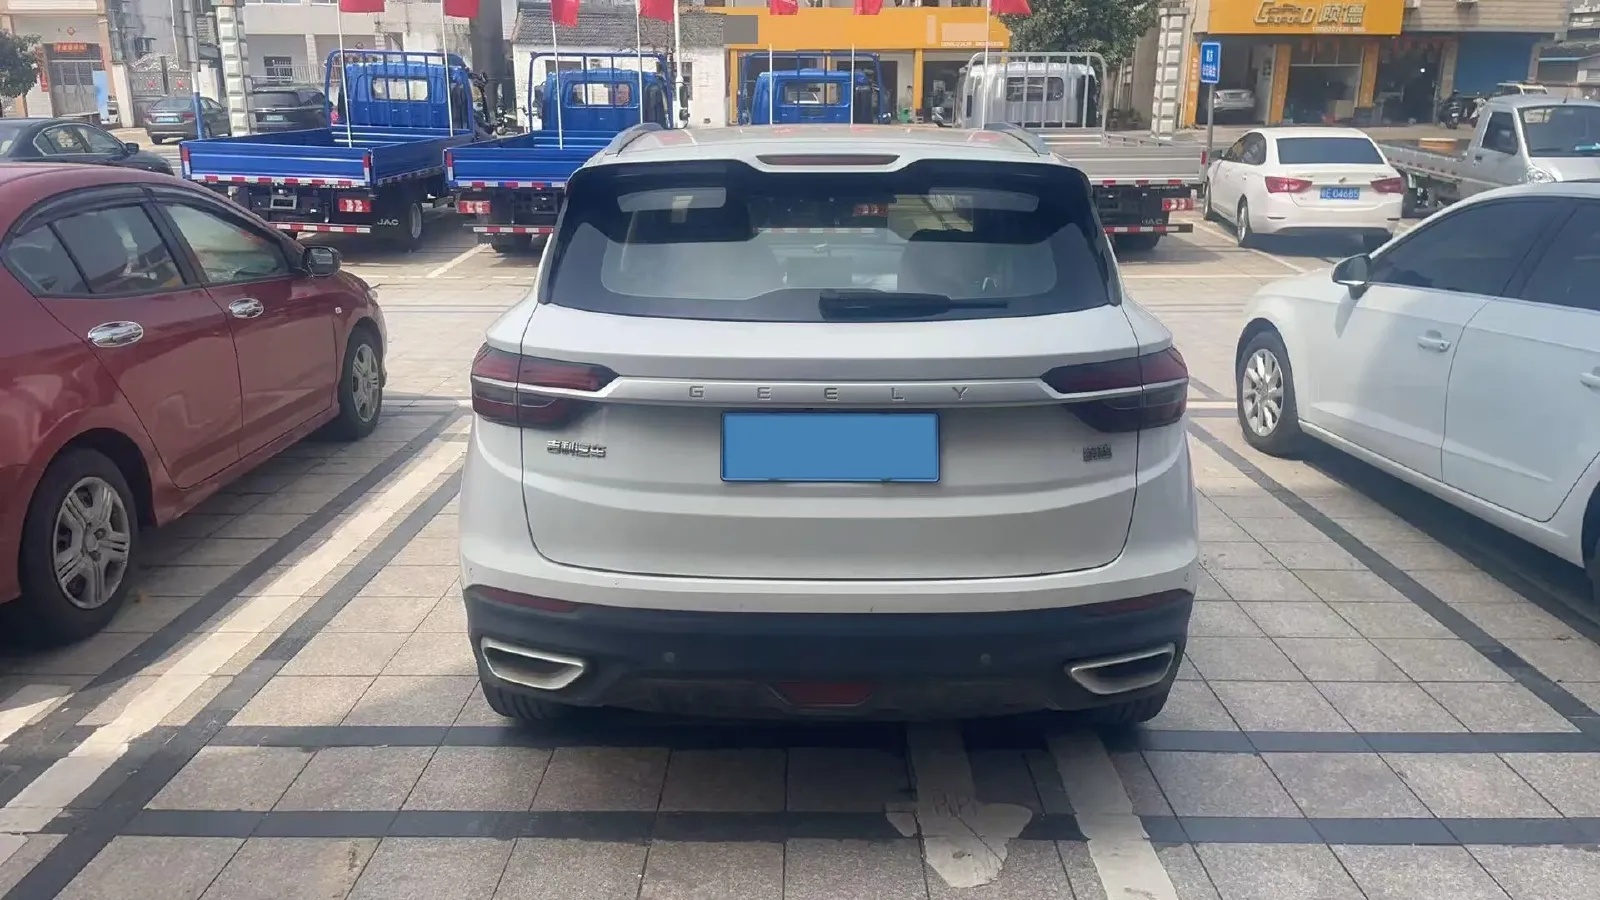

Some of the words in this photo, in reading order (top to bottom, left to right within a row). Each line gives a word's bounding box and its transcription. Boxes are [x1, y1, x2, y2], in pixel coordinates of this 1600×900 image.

[375, 216, 399, 226] JAC
[688, 385, 968, 401] GEELY
[547, 440, 607, 458] 吉利汽车
